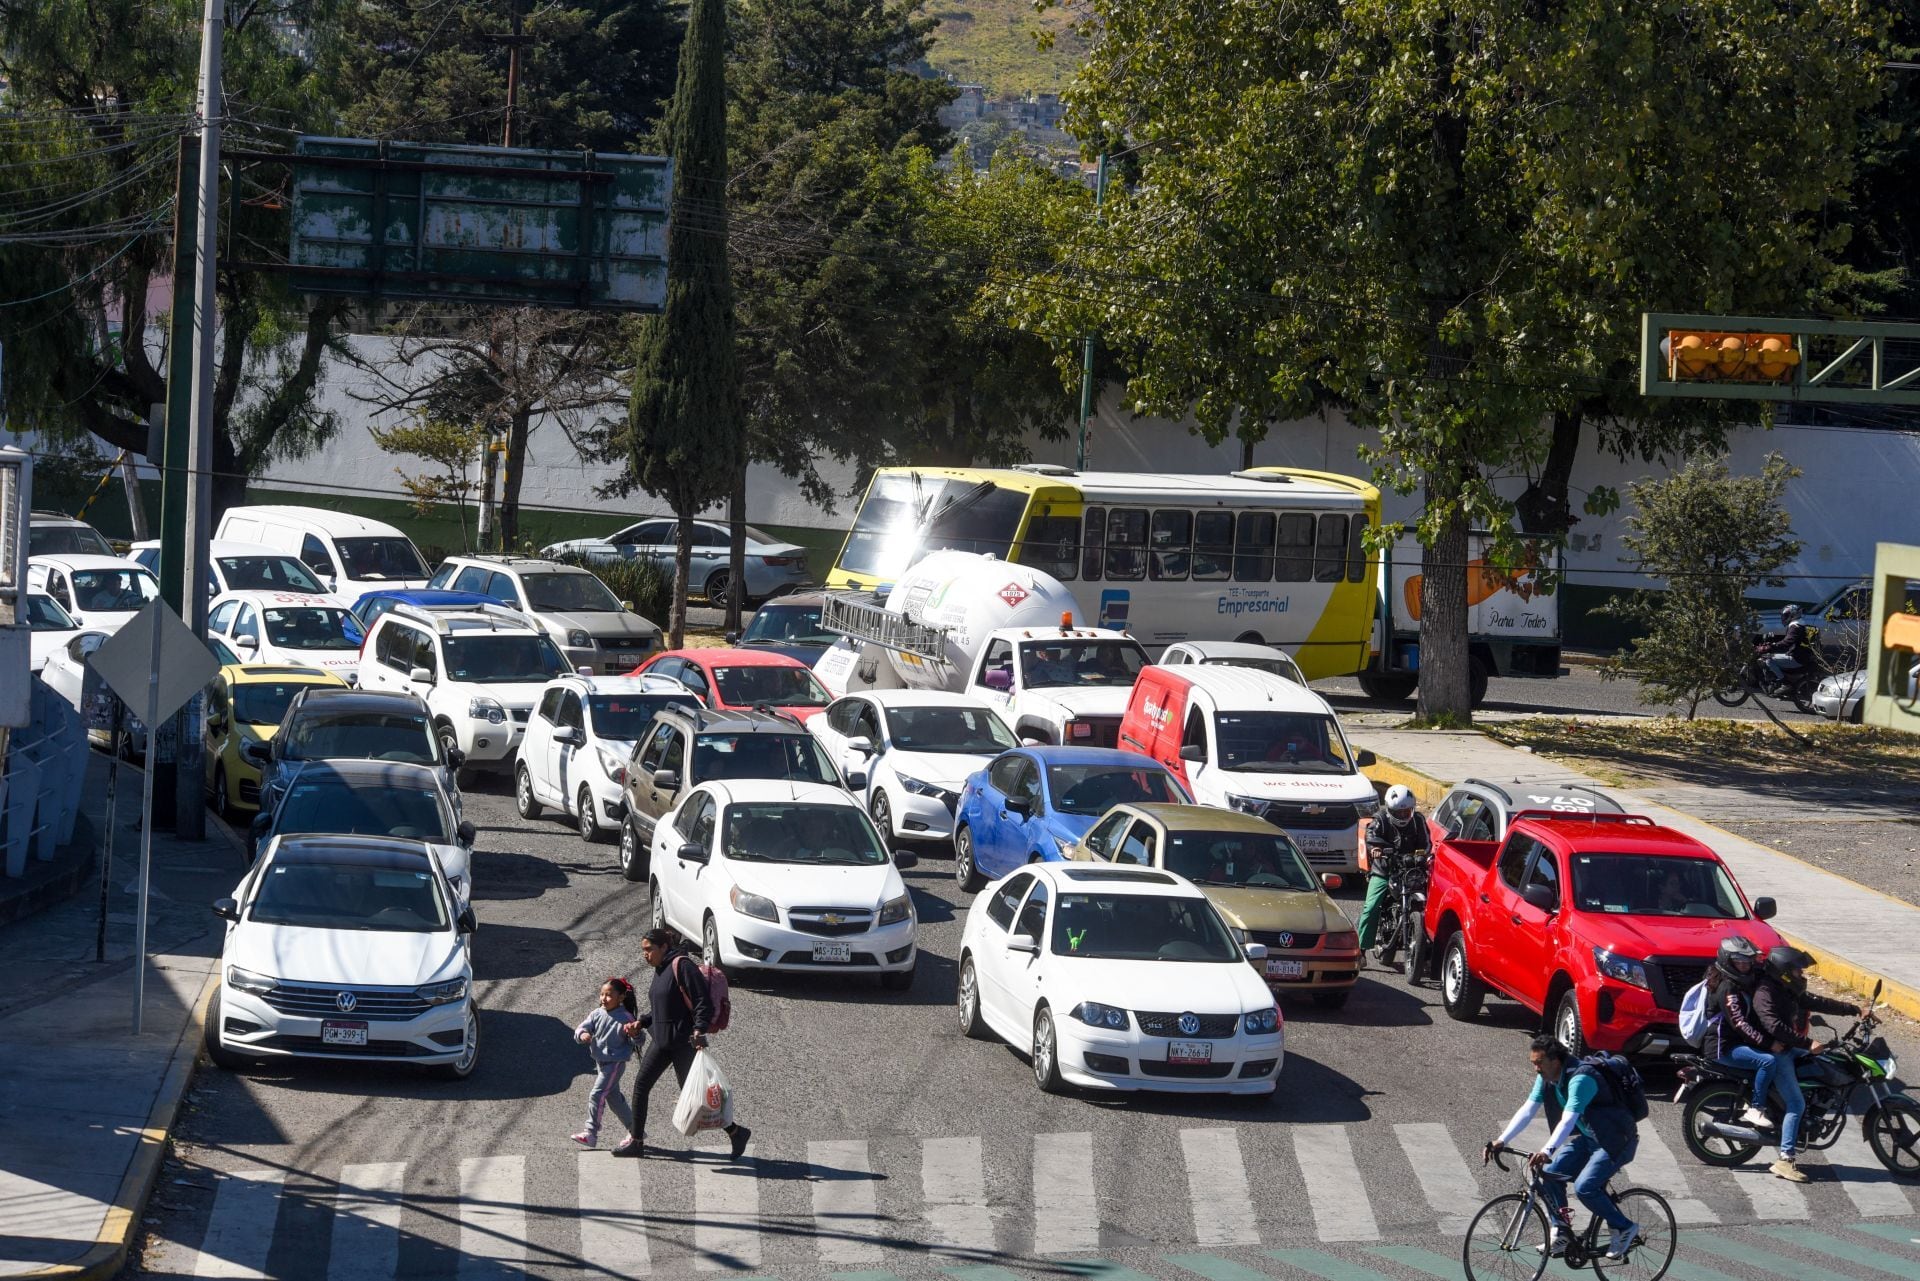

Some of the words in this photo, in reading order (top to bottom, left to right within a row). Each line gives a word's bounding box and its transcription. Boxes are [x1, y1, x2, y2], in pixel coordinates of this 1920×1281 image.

[1218, 596, 1289, 617] Empresarial
[1488, 610, 1514, 627] Para
[1521, 612, 1546, 628] Todos
[1527, 794, 1595, 807] 074
[1551, 804, 1589, 813] ECO
[814, 946, 850, 956] MAS-733-A
[1170, 1047, 1209, 1058] NKY-266-B
